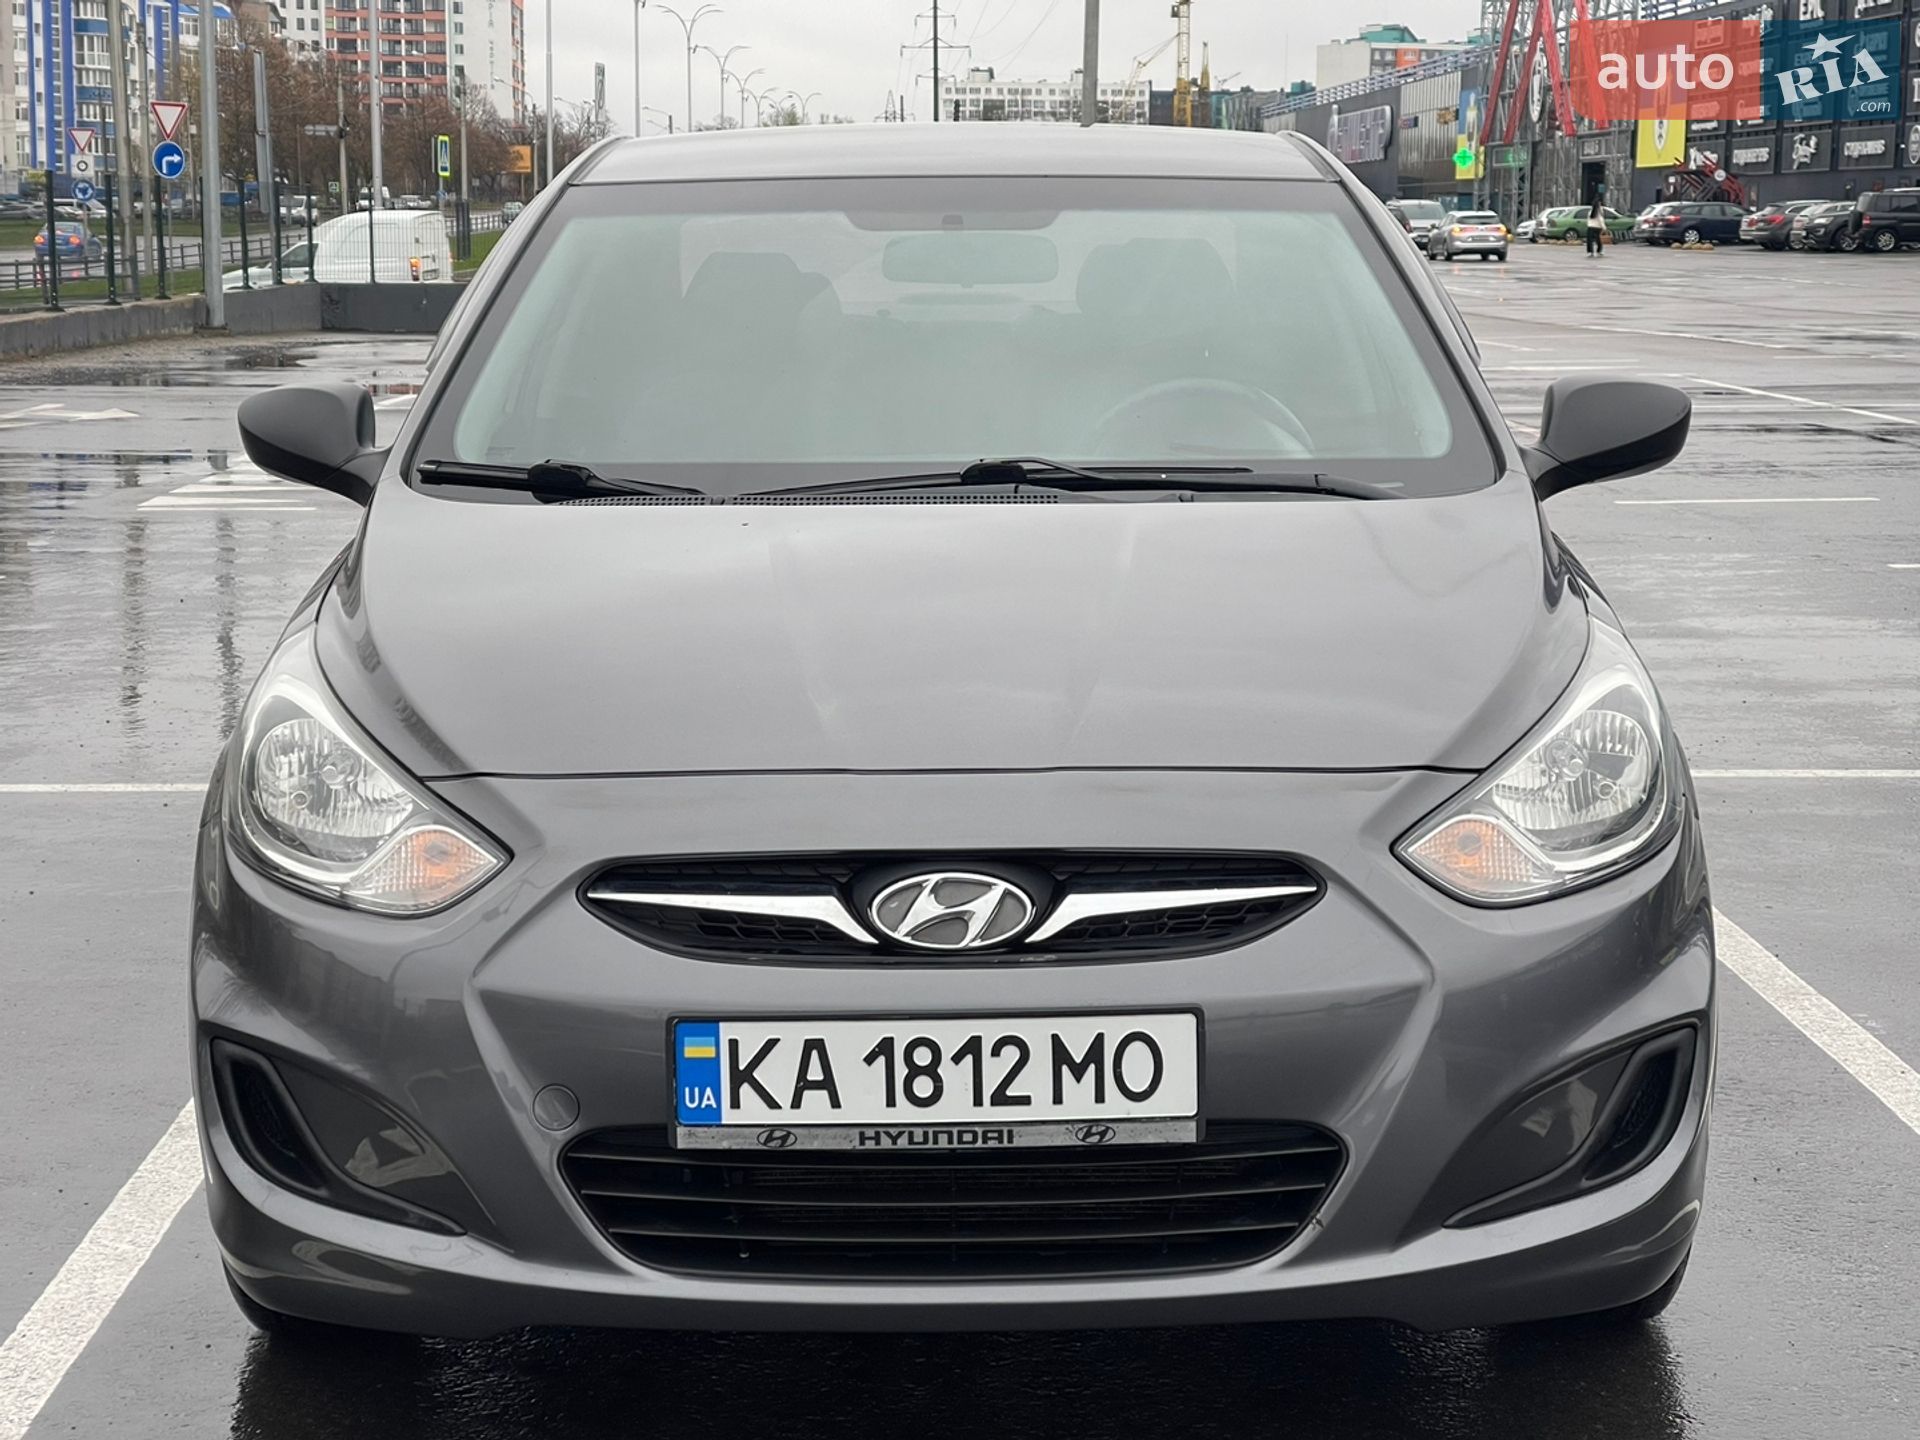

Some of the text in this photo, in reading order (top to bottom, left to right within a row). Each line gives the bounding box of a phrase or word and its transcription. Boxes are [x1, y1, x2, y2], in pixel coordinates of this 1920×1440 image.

[727, 1030, 1163, 1110] KA 1812 MO
[684, 1086, 717, 1109] UA
[858, 1128, 1014, 1147] HYUNDAI
